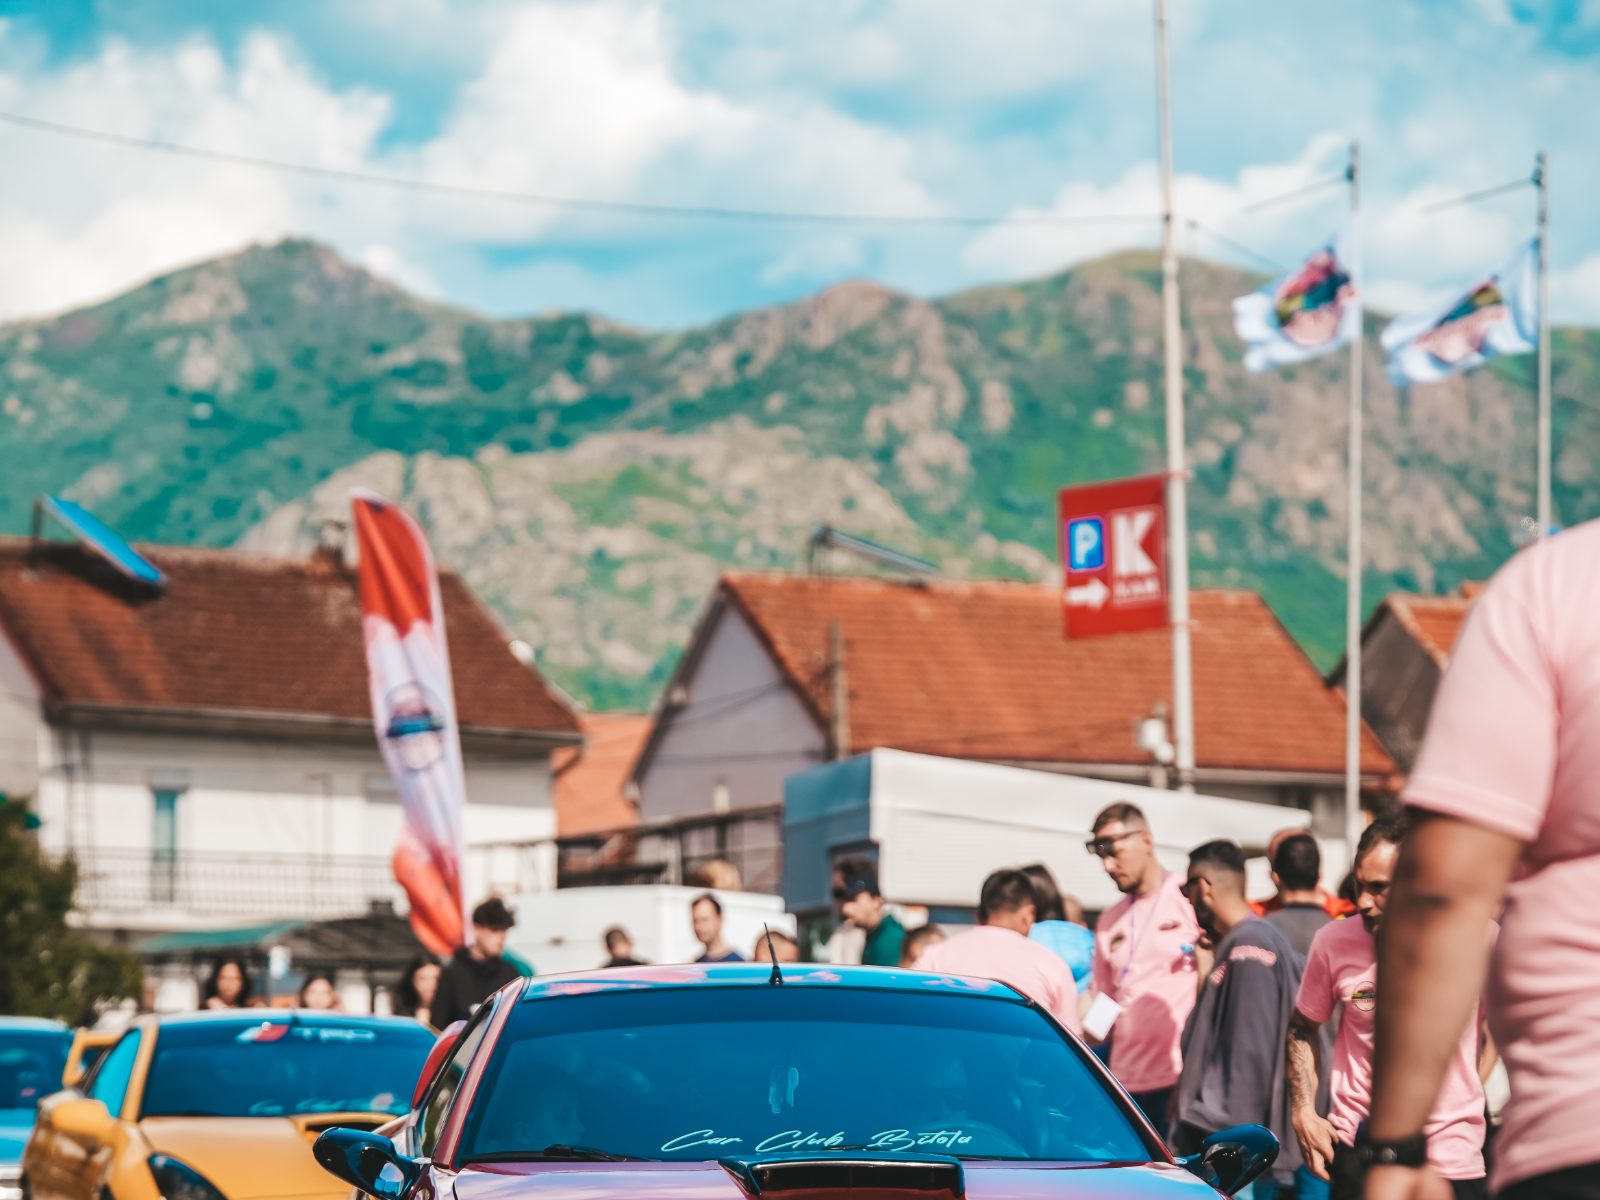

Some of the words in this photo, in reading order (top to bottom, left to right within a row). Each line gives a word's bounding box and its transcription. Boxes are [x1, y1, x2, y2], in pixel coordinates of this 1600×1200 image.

[1074, 522, 1099, 565] P
[1113, 511, 1157, 576] K
[660, 1129, 743, 1152] Car
[755, 1129, 845, 1152] Club
[866, 1129, 973, 1152] Bitola
